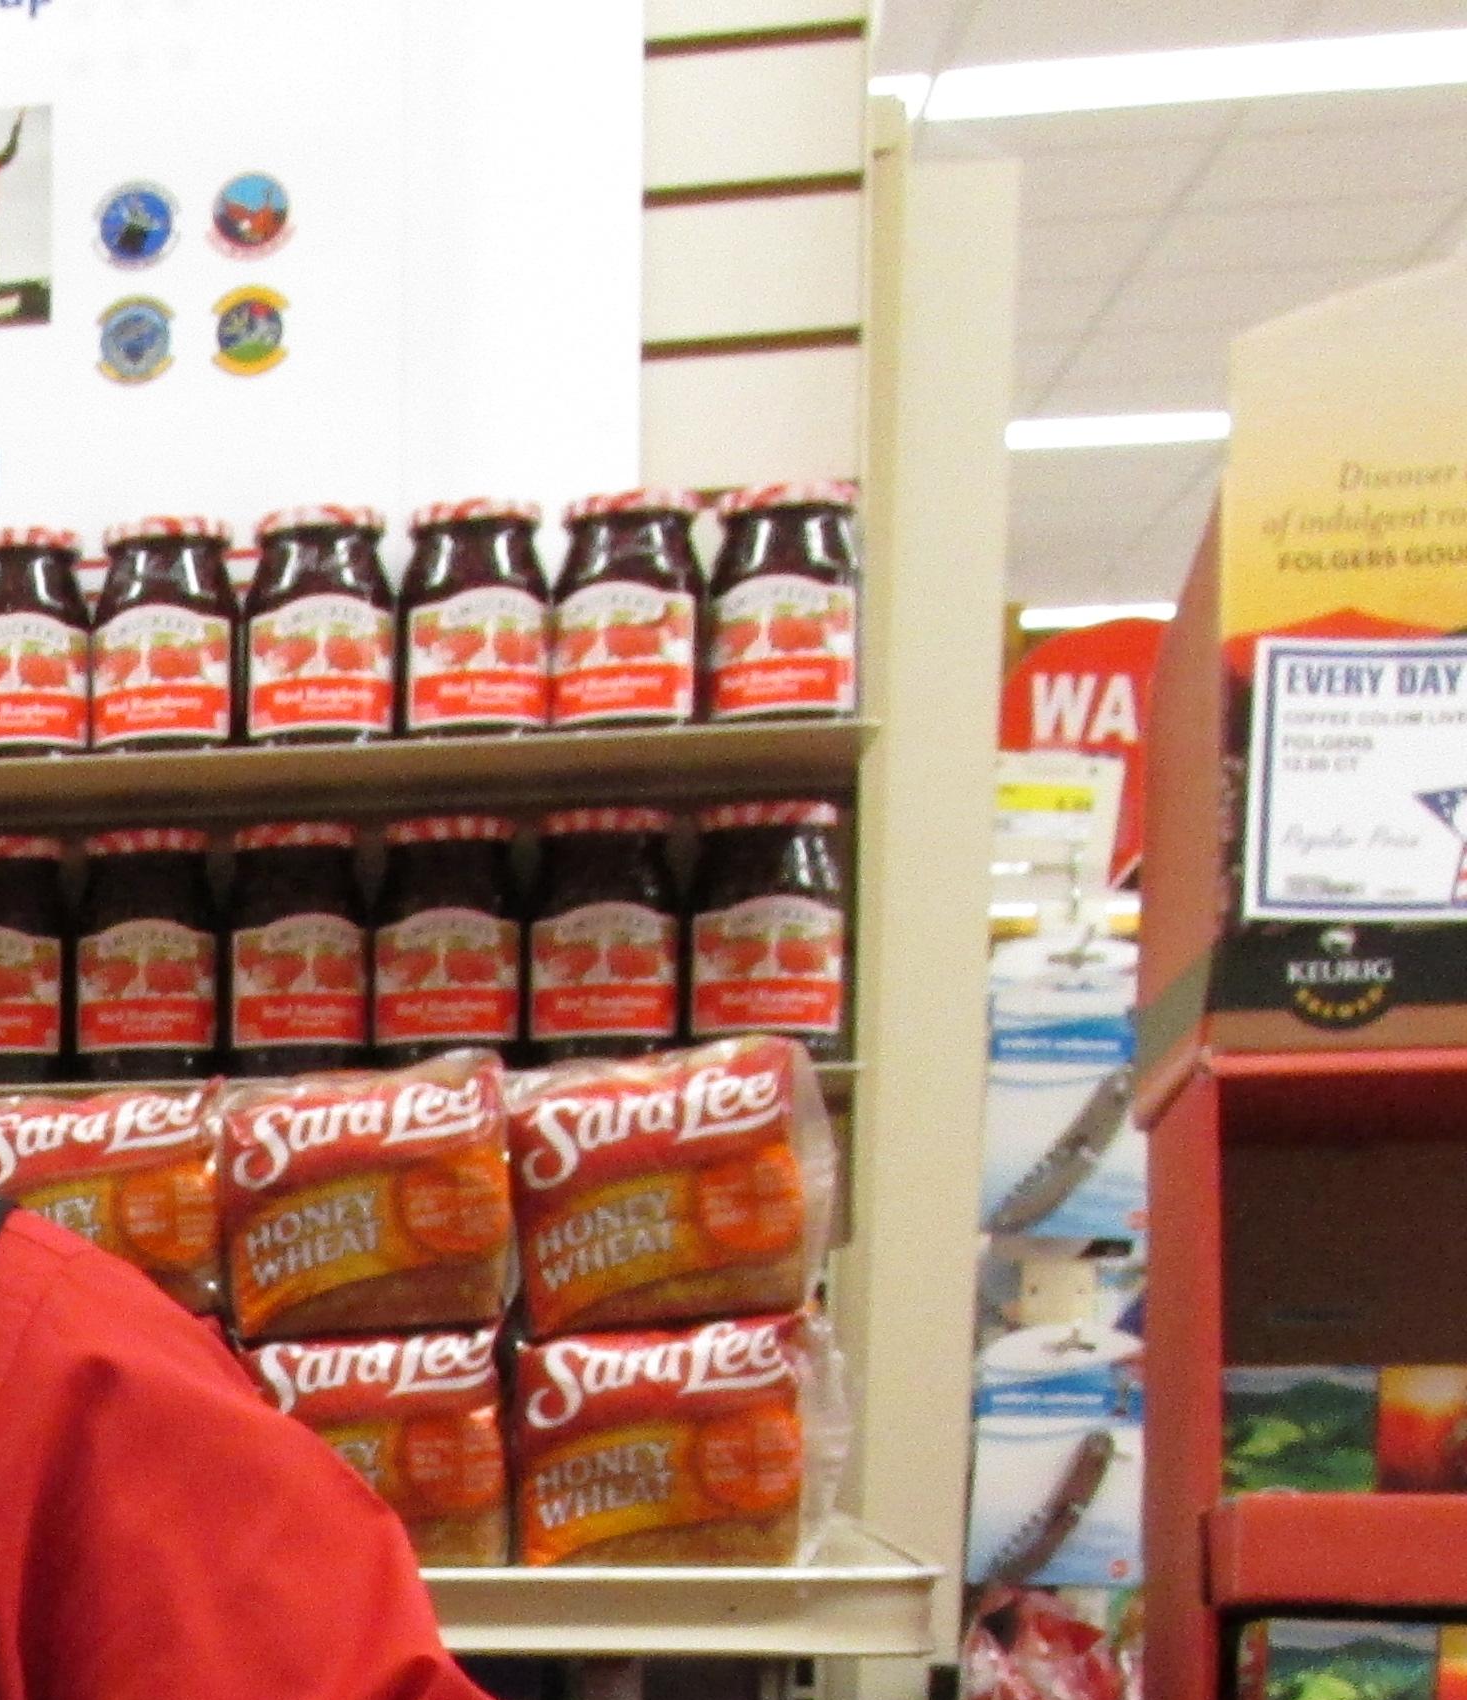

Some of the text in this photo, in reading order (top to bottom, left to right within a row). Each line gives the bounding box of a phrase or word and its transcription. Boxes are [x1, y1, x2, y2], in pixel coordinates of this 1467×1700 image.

[1287, 664, 1462, 695] EVERY DAY
[105, 1088, 205, 1154] Lee
[232, 1072, 488, 1191] Sara Lee
[521, 1065, 783, 1192] Sara Lee
[259, 1327, 498, 1415] Sara Lee
[524, 1321, 791, 1430] Sara Lee
